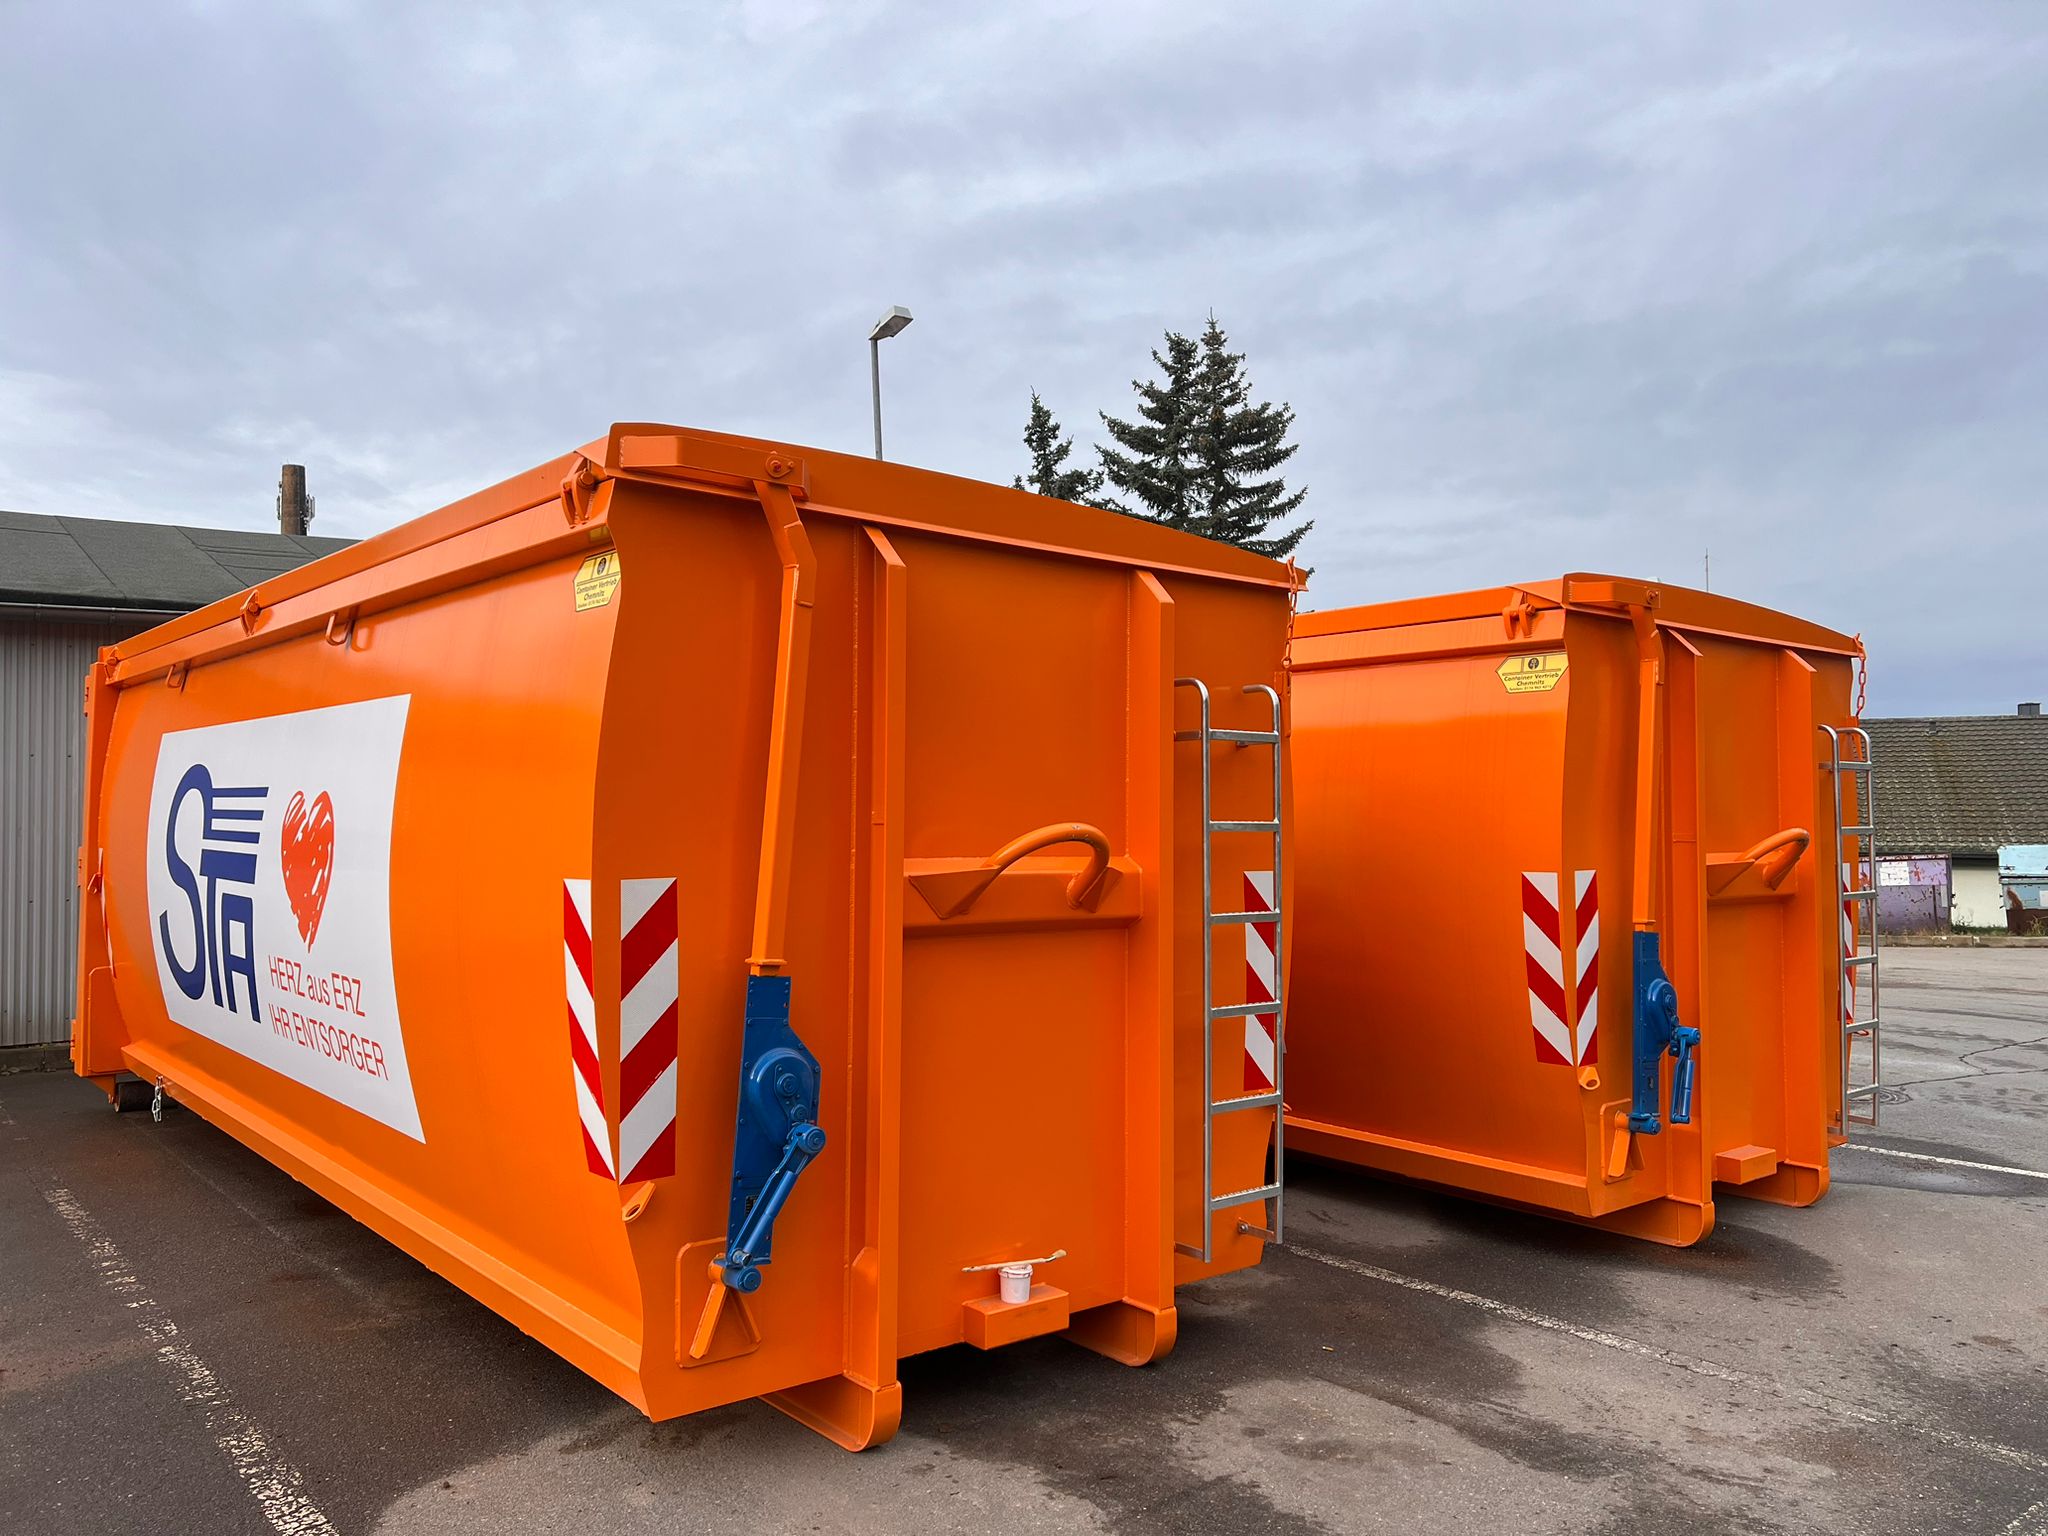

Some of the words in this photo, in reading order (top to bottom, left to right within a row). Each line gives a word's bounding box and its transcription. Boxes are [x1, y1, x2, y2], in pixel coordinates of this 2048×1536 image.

[268, 954, 306, 998] HERZ
[306, 974, 331, 1007] aus
[331, 972, 366, 1018] ERZ
[268, 1003, 295, 1042] IHR
[292, 1011, 389, 1081] ENTSORGER
